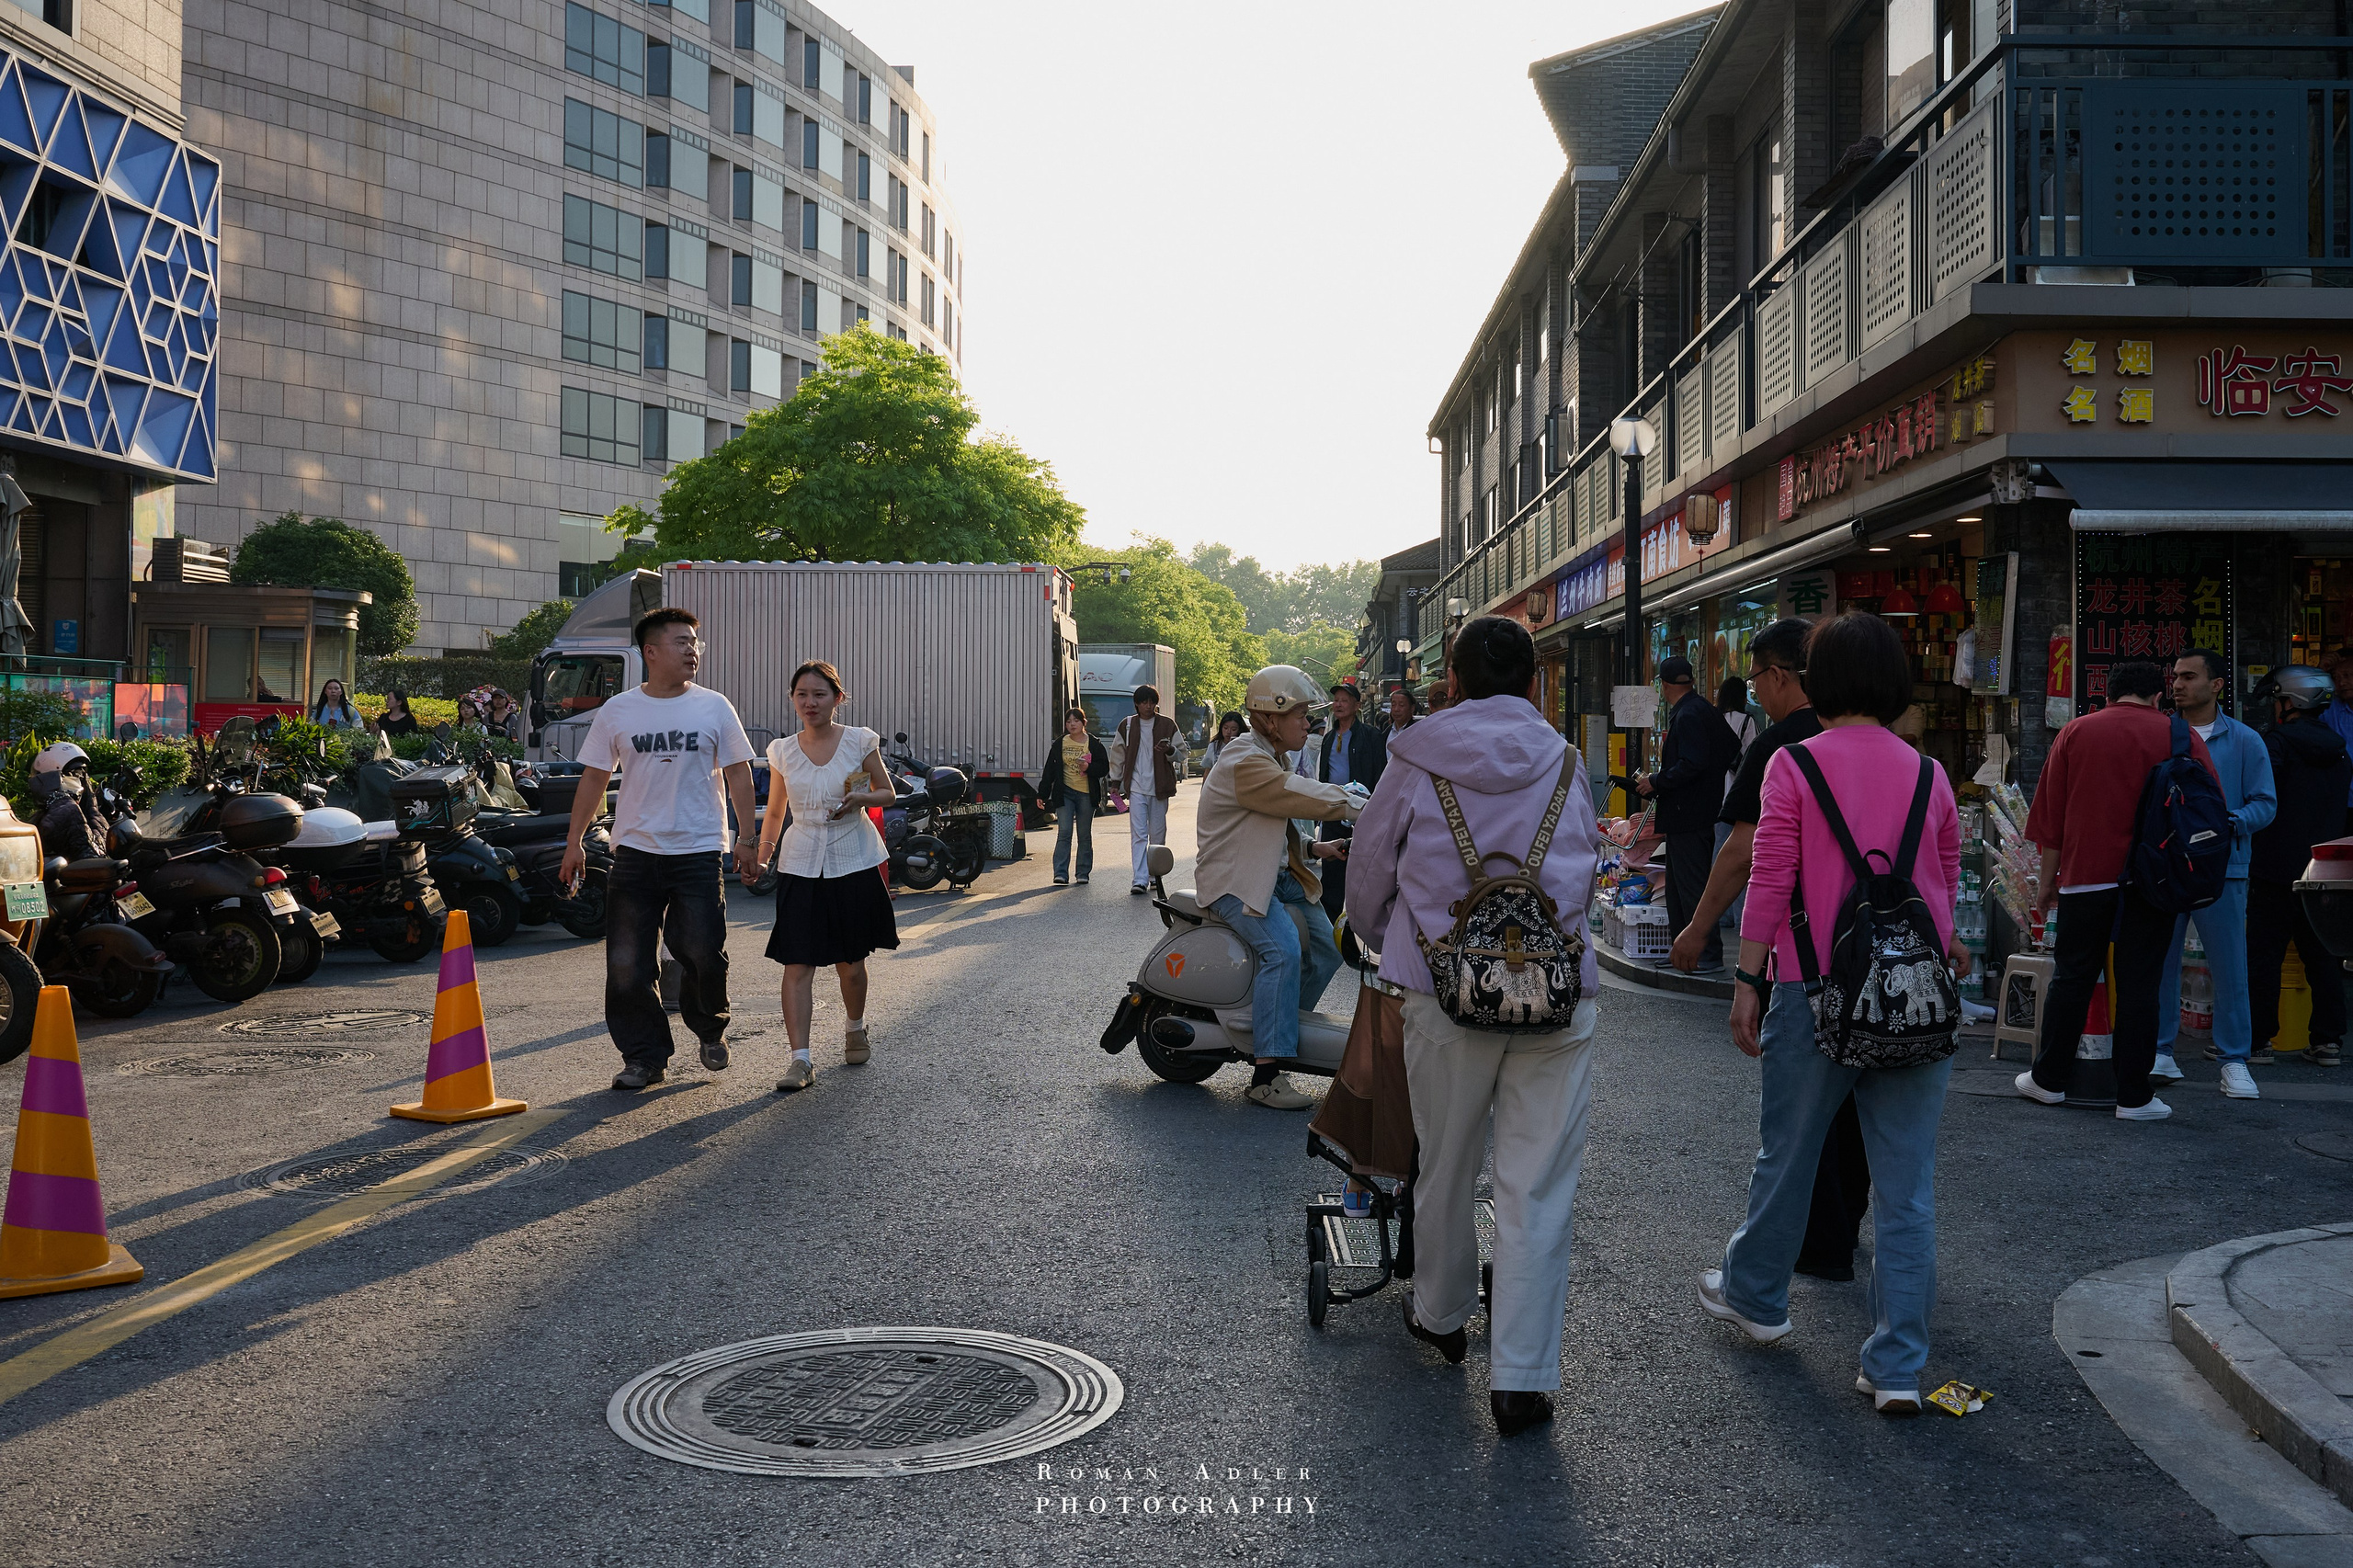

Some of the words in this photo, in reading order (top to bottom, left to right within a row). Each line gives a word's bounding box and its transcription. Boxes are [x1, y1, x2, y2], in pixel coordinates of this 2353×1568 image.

[2063, 338, 2154, 375] 名烟
[2198, 345, 2353, 416] 临安
[2063, 385, 2154, 423] 名酒
[2085, 536, 2224, 574] 杭州特产
[1560, 563, 1603, 616] 兰州牛肉面
[1786, 578, 1829, 616] 香
[2085, 577, 2188, 616] 龙井茶
[2086, 619, 2188, 658] 山核桃
[631, 729, 699, 754] WAKE
[1435, 778, 1457, 809] DAN
[1549, 785, 1567, 815] DAN
[1447, 807, 1463, 828] YA
[1542, 813, 1558, 829] YA
[1453, 826, 1472, 848] FEI
[1534, 829, 1552, 850] FEI
[1461, 847, 1479, 867] OU
[1528, 847, 1544, 867] OU
[21, 901, 45, 915] 08502
